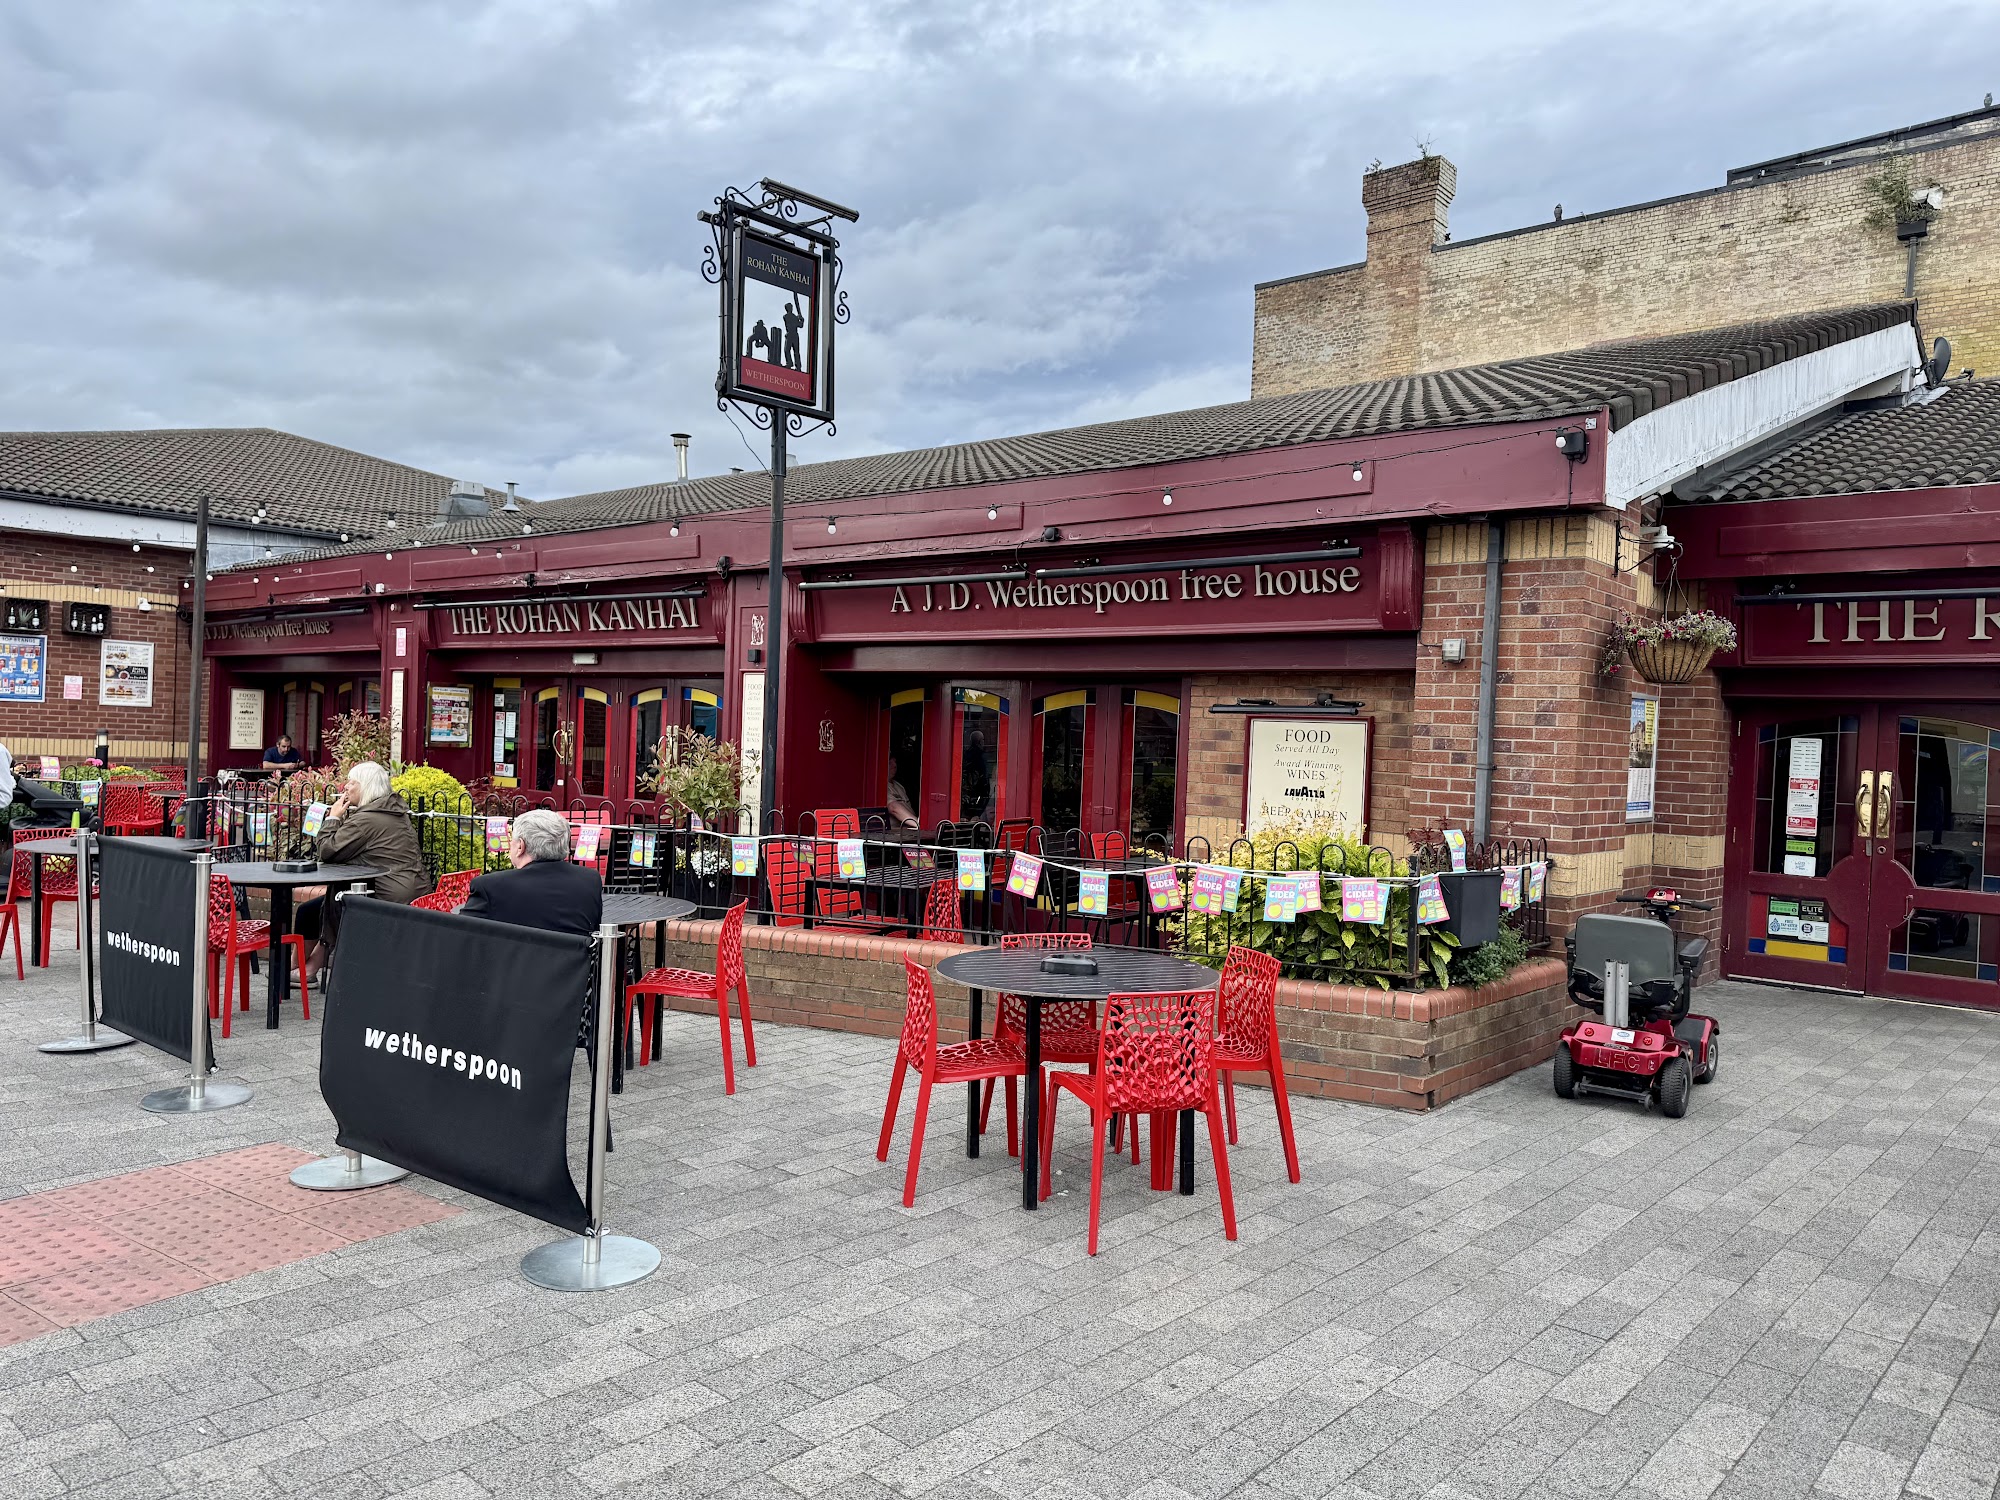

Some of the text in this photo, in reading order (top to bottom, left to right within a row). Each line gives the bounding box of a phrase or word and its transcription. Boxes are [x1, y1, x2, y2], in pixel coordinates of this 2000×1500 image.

[771, 254, 787, 267] THE
[747, 257, 810, 286] ROHAN KANHAI
[745, 368, 805, 392] WETHERSPOON
[890, 586, 911, 612] A
[986, 576, 1170, 613] Wetherspoon
[1179, 568, 1243, 600] free
[1254, 564, 1360, 596] house
[446, 598, 700, 634] THE ROHAN KANHAI
[1797, 599, 1946, 642] THE
[232, 623, 284, 642] Wetherspoon
[285, 620, 302, 636] free
[304, 619, 330, 634] house
[1285, 729, 1331, 742] FOOD
[1275, 744, 1303, 753] Served
[1322, 746, 1340, 756] Day
[1274, 759, 1340, 771] Award Winning
[1287, 770, 1325, 780] WINES
[1284, 786, 1325, 798] LAVAZZA
[1299, 809, 1348, 821] GARDEN
[1015, 858, 1040, 870] CRAFT
[1014, 864, 1038, 877] CIDER
[1149, 872, 1172, 882] CRAFT
[1198, 873, 1224, 882] CRAFT
[1082, 883, 1106, 891] CIDER
[1150, 879, 1175, 889] CIDER
[1197, 881, 1222, 891] CIDER
[1298, 881, 1316, 890] DER
[1269, 890, 1295, 899] CIDER
[1345, 890, 1374, 898] CIDER
[107, 931, 180, 966] wetherspoon
[365, 1027, 521, 1090] wetherspoon
[1593, 1048, 1640, 1072] LFC
